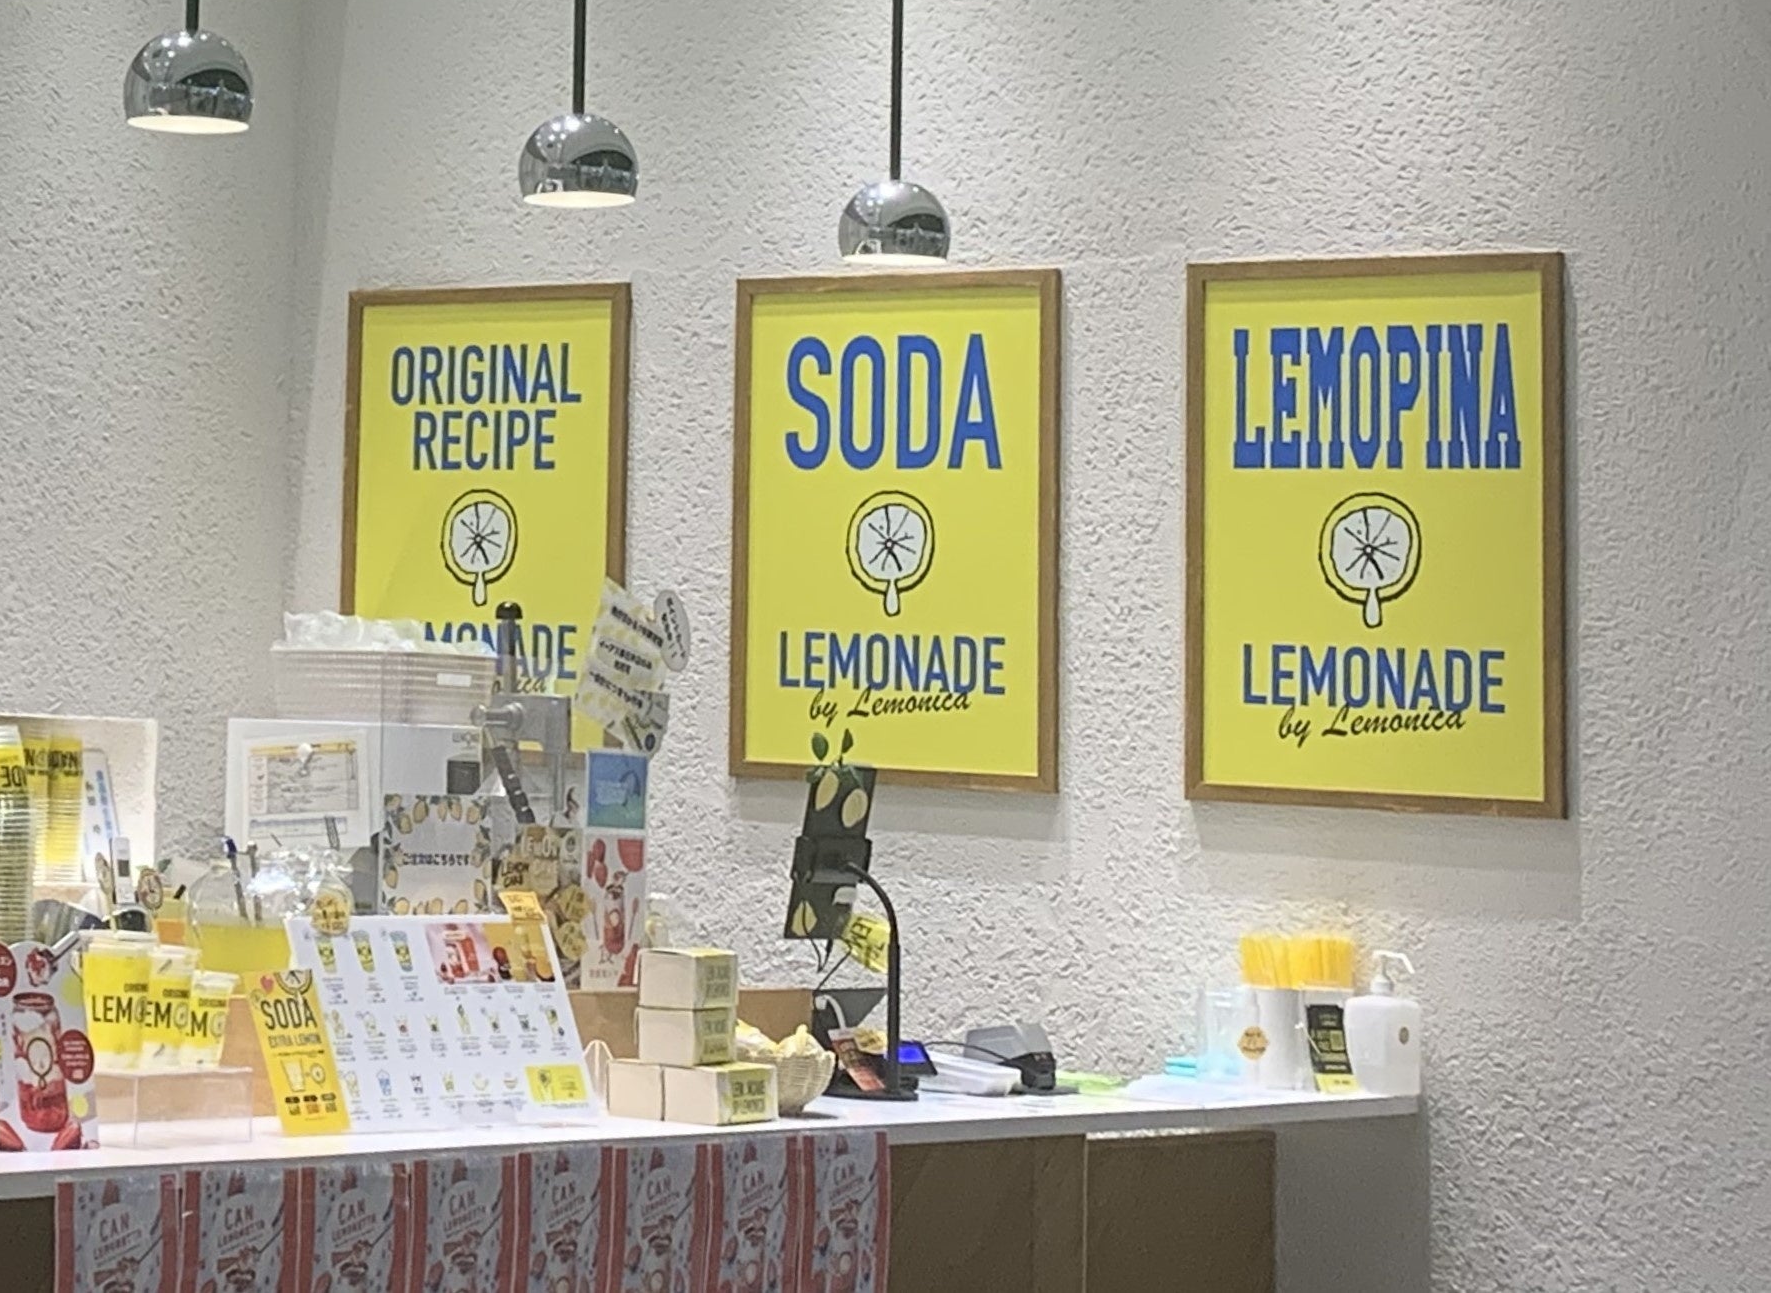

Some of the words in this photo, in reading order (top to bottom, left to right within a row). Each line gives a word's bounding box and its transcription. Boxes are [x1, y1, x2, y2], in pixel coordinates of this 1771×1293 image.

[390, 343, 582, 406] ORIGINAL
[785, 333, 1003, 470] SODA
[1232, 322, 1522, 470] LEMOPINA
[412, 409, 558, 471] RECIPE
[779, 631, 1007, 696] LEMONADE
[1242, 643, 1506, 714] LEMONADE
[809, 690, 840, 728] by
[846, 687, 973, 719] Lemonica
[1277, 708, 1312, 748] by
[1320, 702, 1467, 738] Lemonica
[260, 996, 319, 1031] SODA
